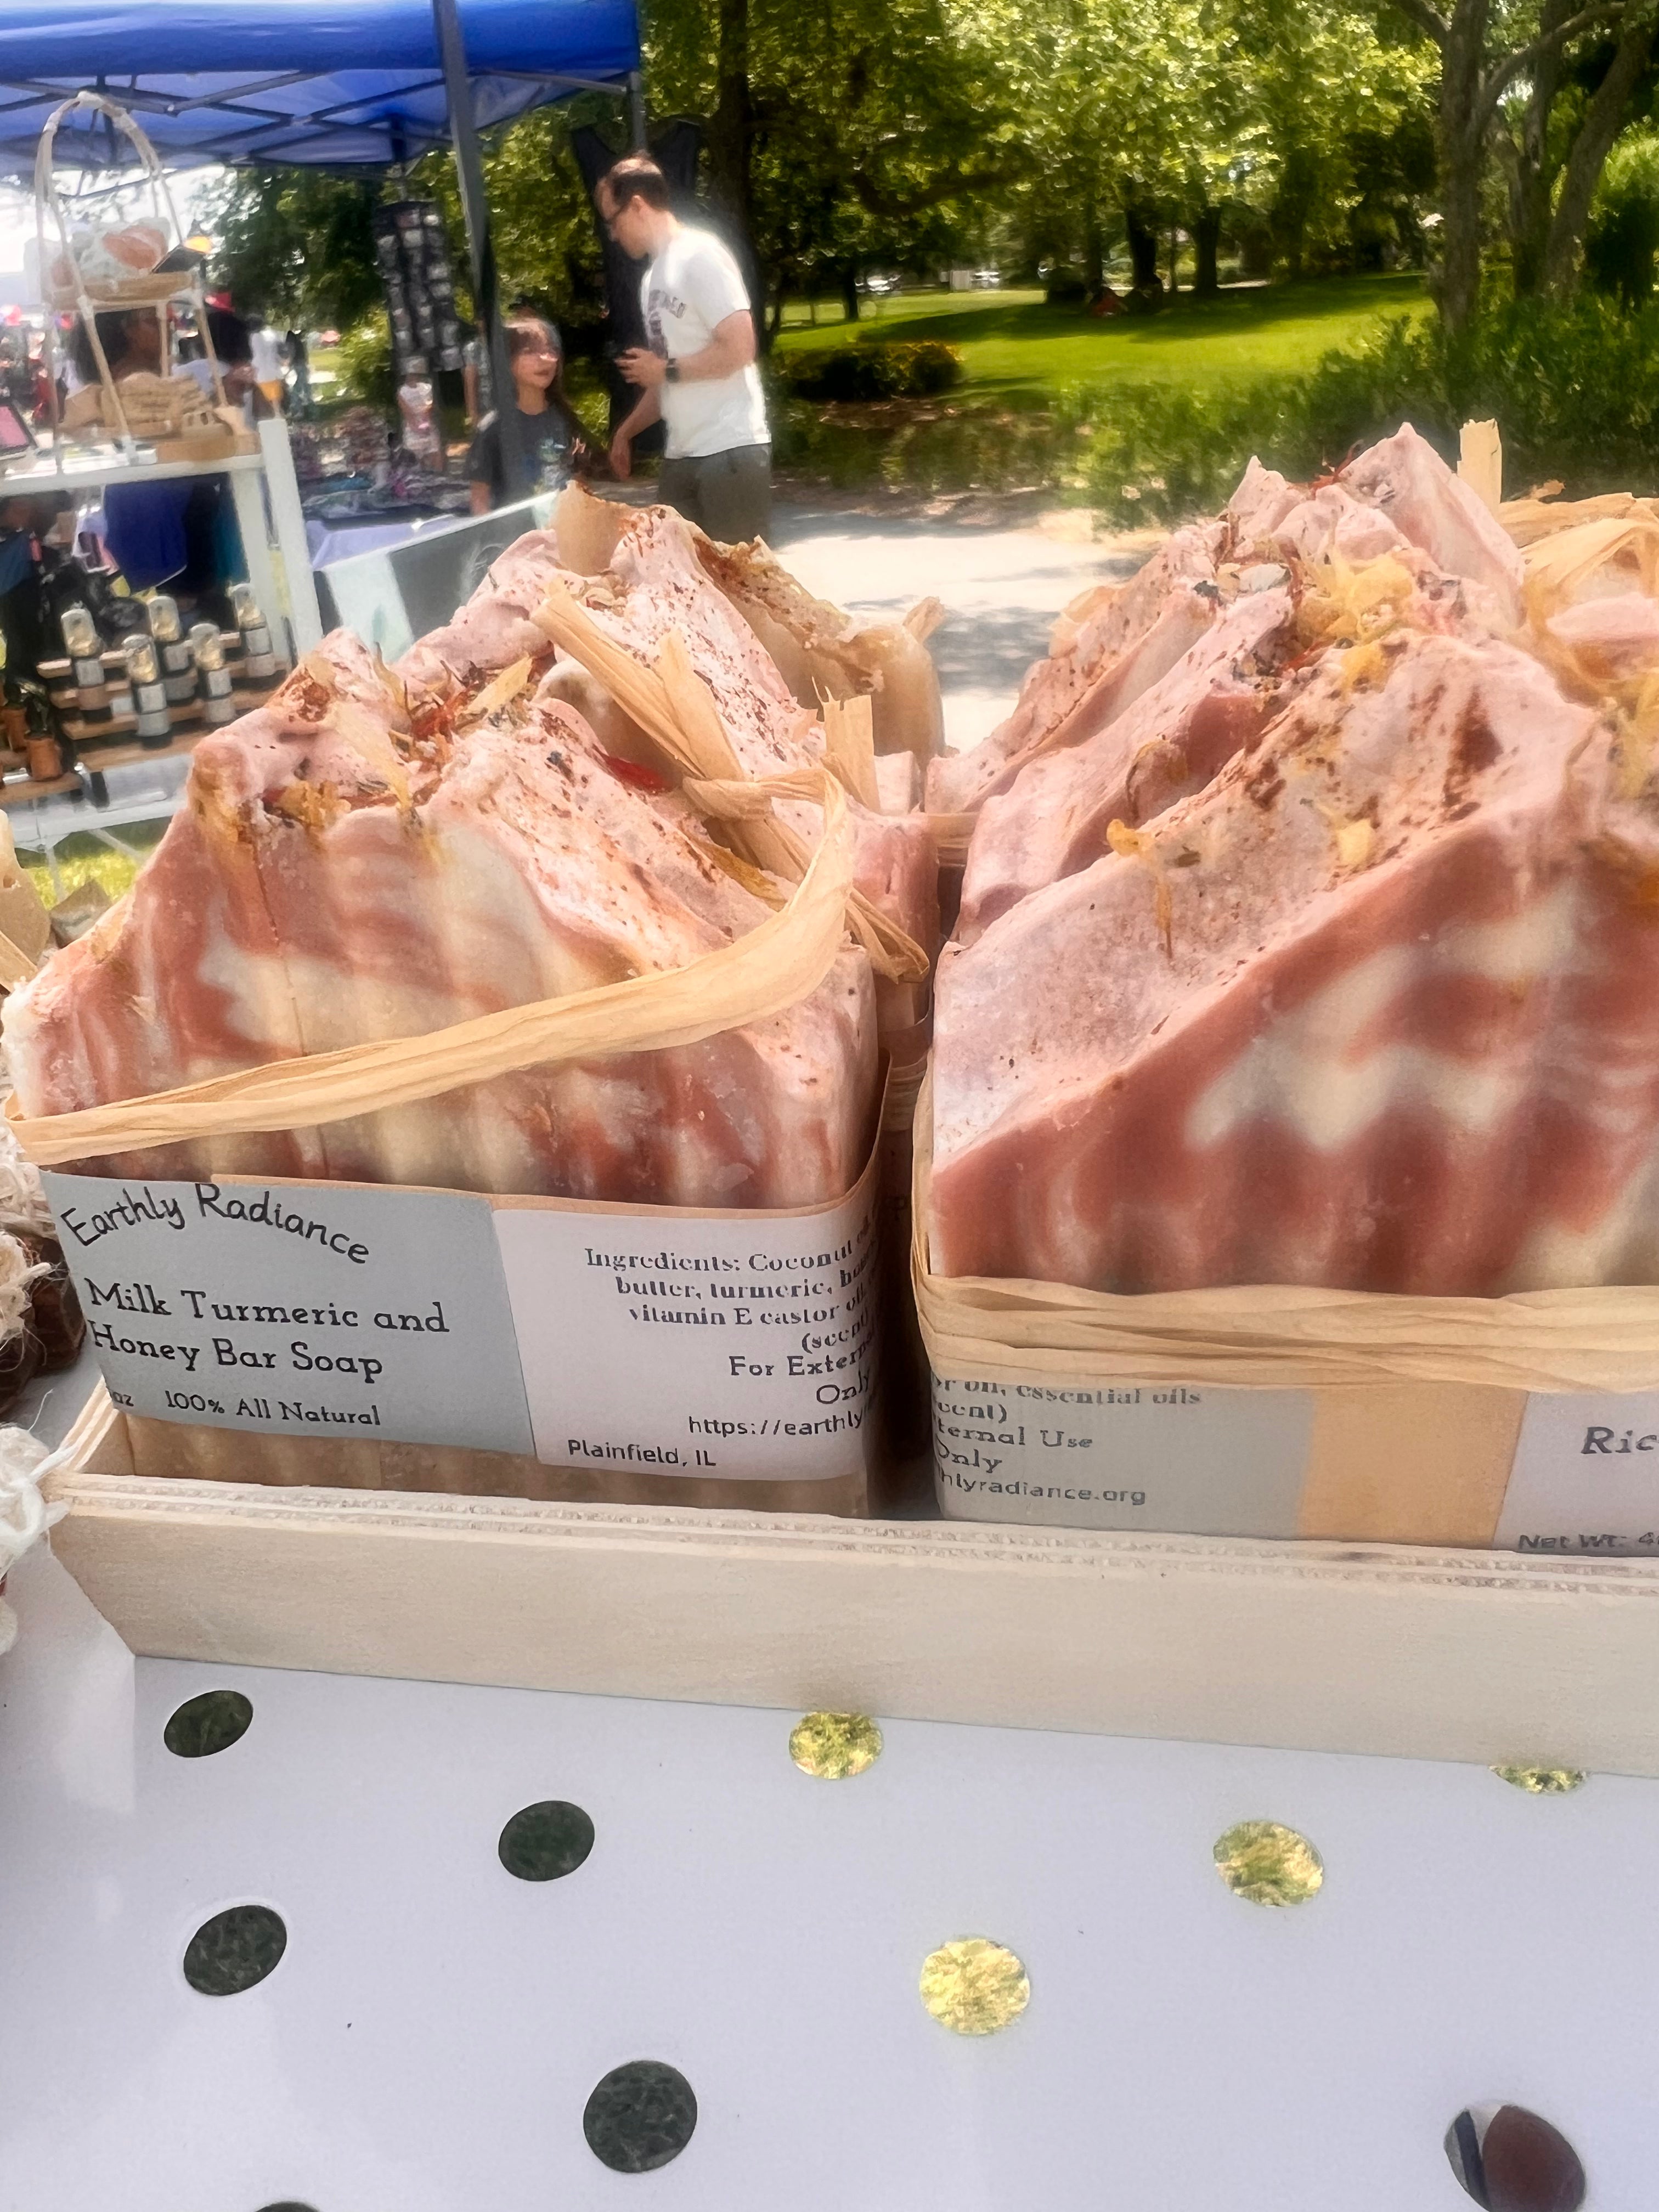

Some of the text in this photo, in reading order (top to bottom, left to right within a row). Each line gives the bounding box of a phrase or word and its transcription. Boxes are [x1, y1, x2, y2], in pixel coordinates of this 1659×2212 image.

[61, 1183, 370, 1265] Earthly Radiance
[585, 1240, 851, 1271] Ingredients: Coconut
[616, 1277, 702, 1300] butter,
[711, 1279, 832, 1299] turmeric,
[84, 1278, 450, 1333] Milk Turmeric and
[629, 1305, 725, 1324] vitamin
[735, 1308, 750, 1325] E
[760, 1304, 840, 1325] castor
[88, 1321, 383, 1385] Honey Bar Soap
[729, 1356, 774, 1375] For
[816, 1368, 870, 1404] Only
[1152, 1389, 1201, 1404] oils
[165, 1390, 225, 1414] 100%
[236, 1397, 271, 1419] All
[278, 1402, 381, 1426] Natural
[568, 1440, 716, 1467] Plainfield, IL
[1040, 1430, 1093, 1448] Use
[1581, 1426, 1659, 1455] Ric
